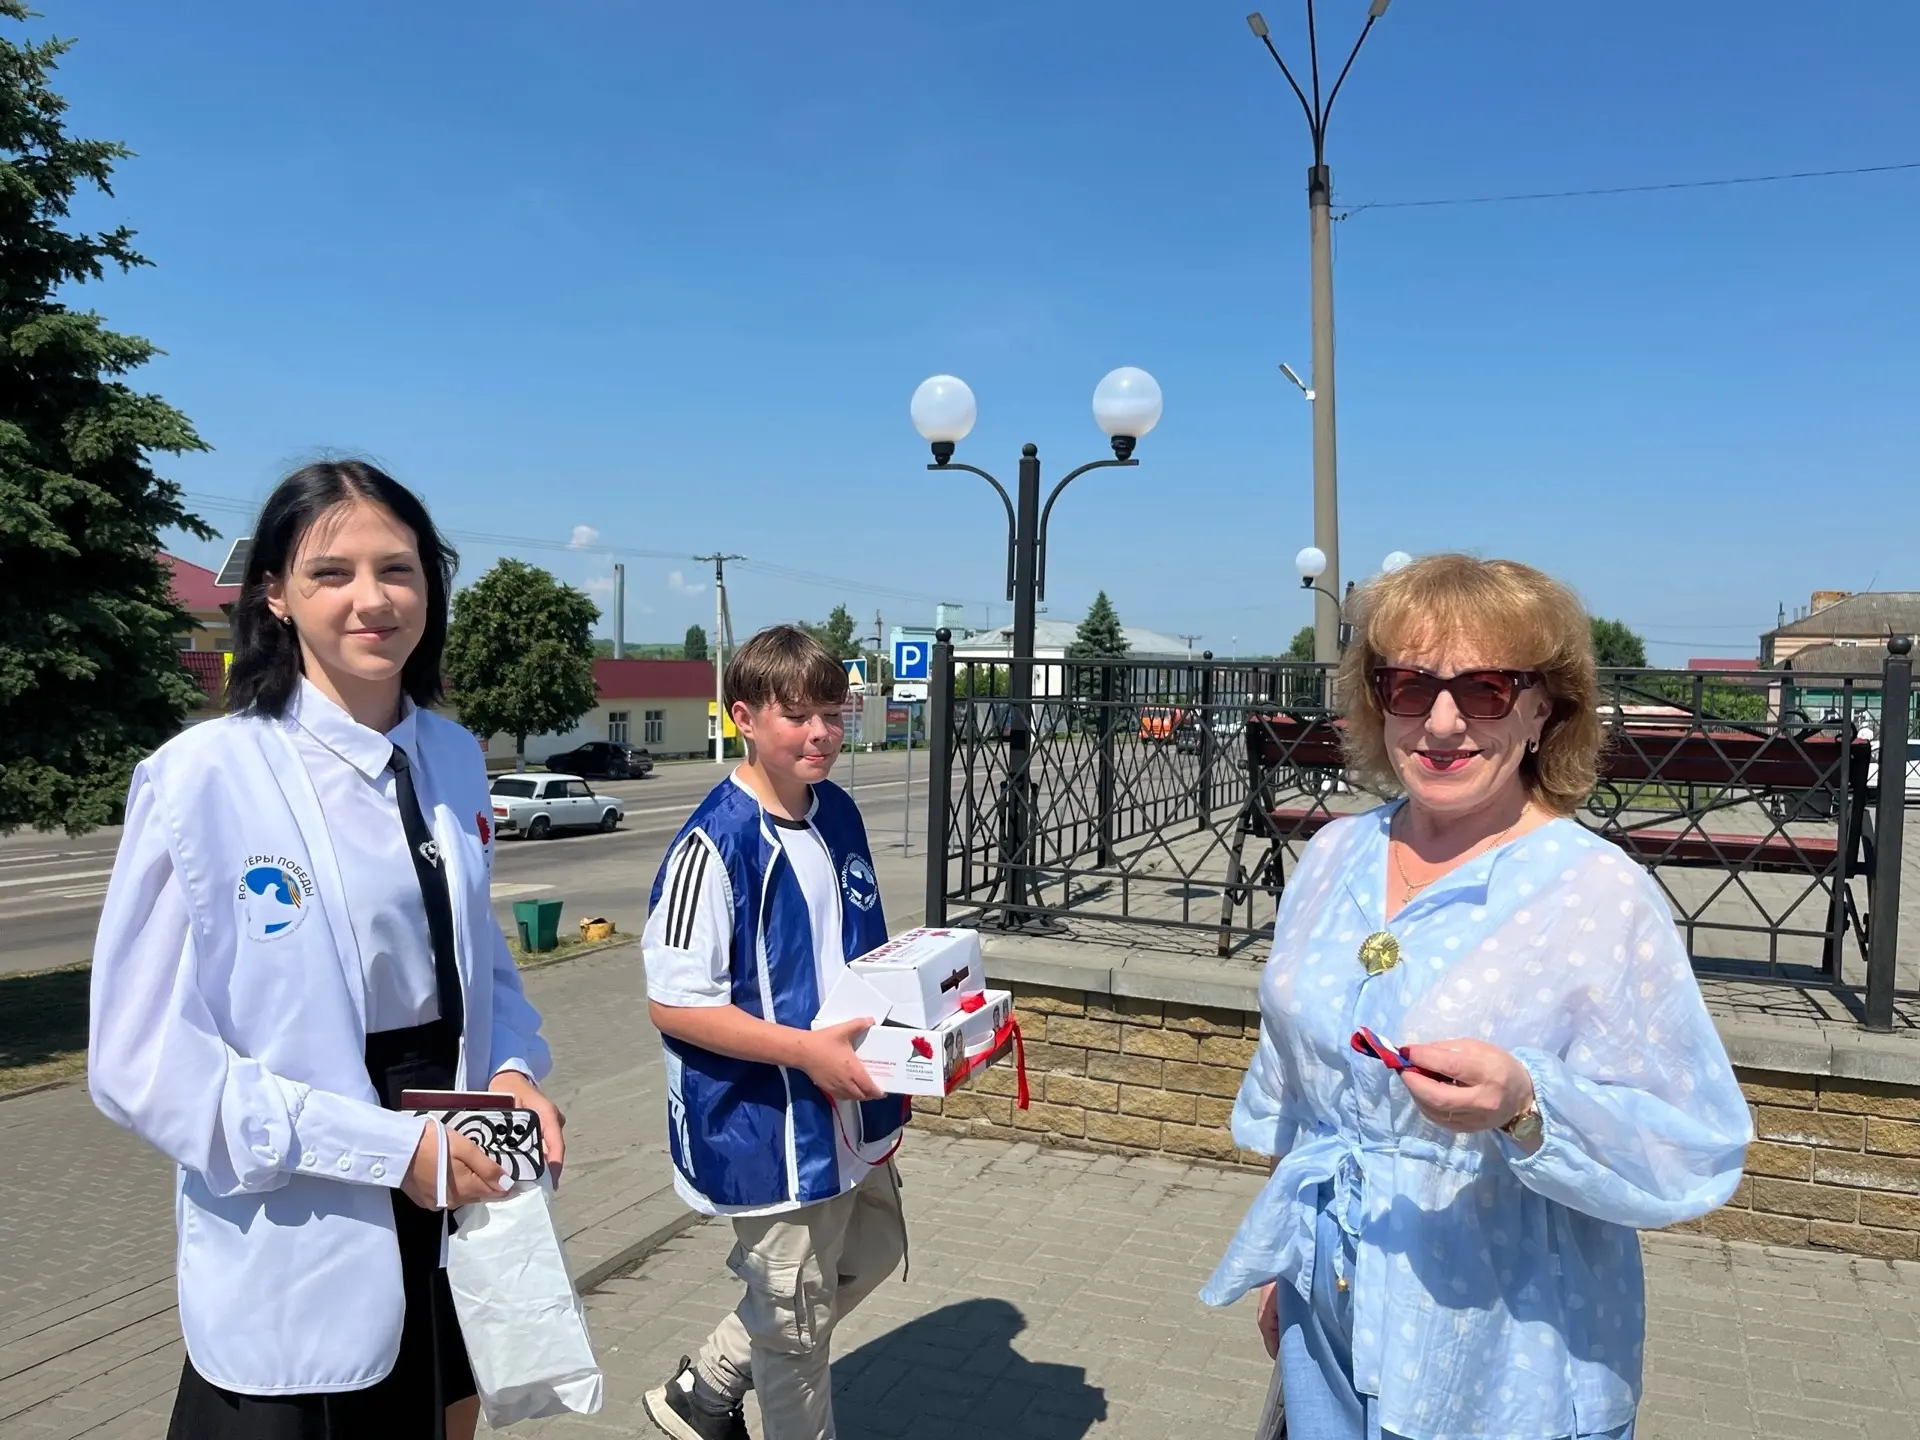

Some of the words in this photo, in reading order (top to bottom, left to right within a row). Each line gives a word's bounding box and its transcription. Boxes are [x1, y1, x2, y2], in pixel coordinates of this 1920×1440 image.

[901, 645, 921, 676] P
[238, 854, 274, 900] ВОЛТЁРЫ
[277, 856, 315, 897] ПОБЕДЫ
